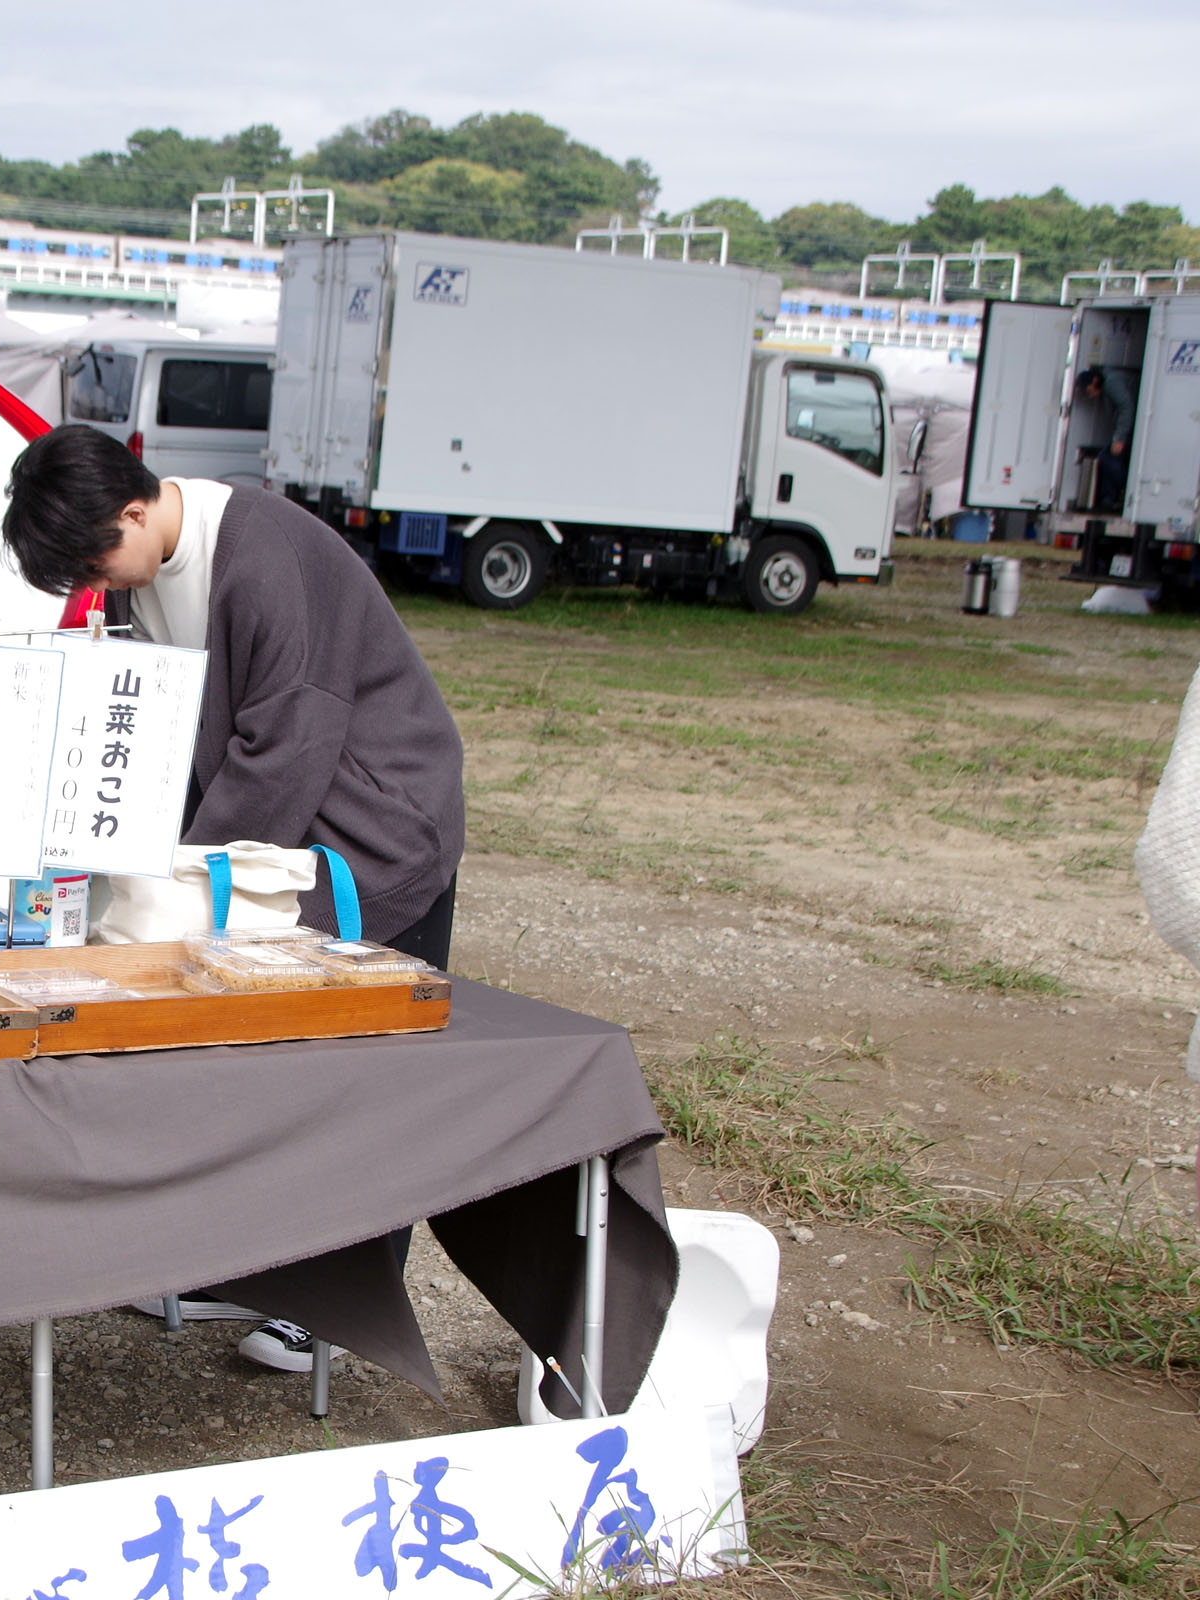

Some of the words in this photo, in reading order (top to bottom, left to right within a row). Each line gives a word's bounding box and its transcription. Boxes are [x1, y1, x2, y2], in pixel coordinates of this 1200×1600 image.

[52, 715, 88, 835] 400円
[90, 669, 141, 838] 山菜おこわ
